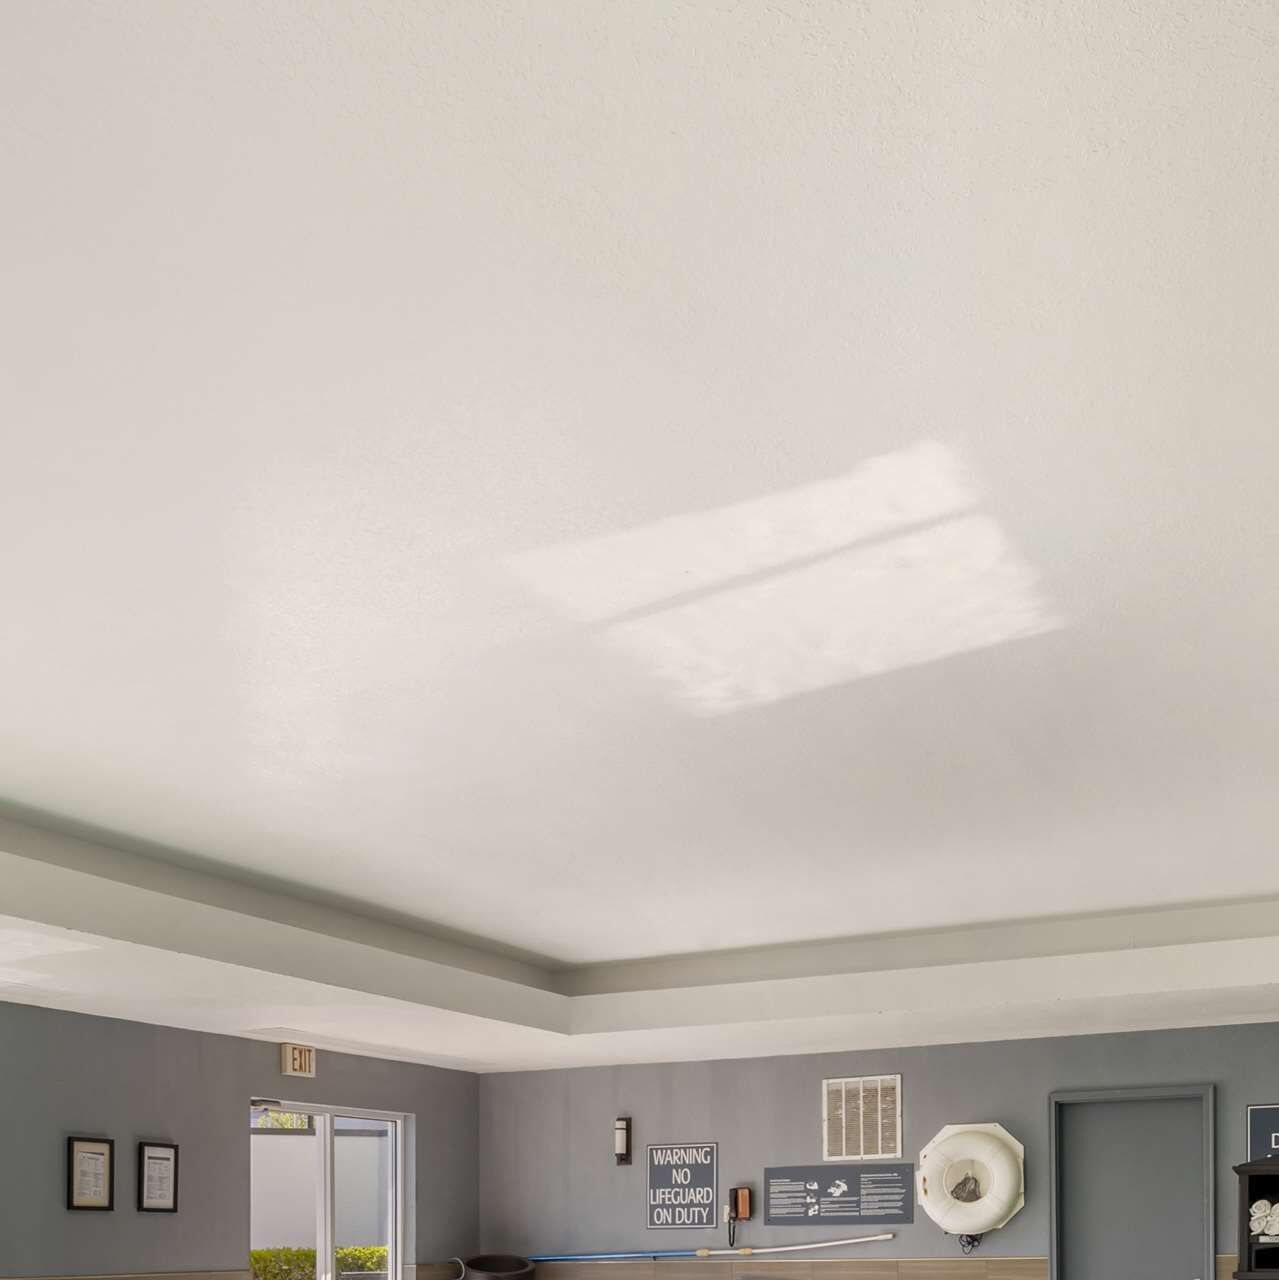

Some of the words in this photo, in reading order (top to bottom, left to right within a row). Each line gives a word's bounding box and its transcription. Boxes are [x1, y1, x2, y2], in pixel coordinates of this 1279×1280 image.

[292, 1047, 313, 1073] EXIT
[652, 1147, 711, 1165] WARNING
[672, 1168, 691, 1185] NO
[650, 1187, 713, 1205] LIFEGUARD
[653, 1208, 672, 1224] ON
[675, 1207, 709, 1224] DUTY
